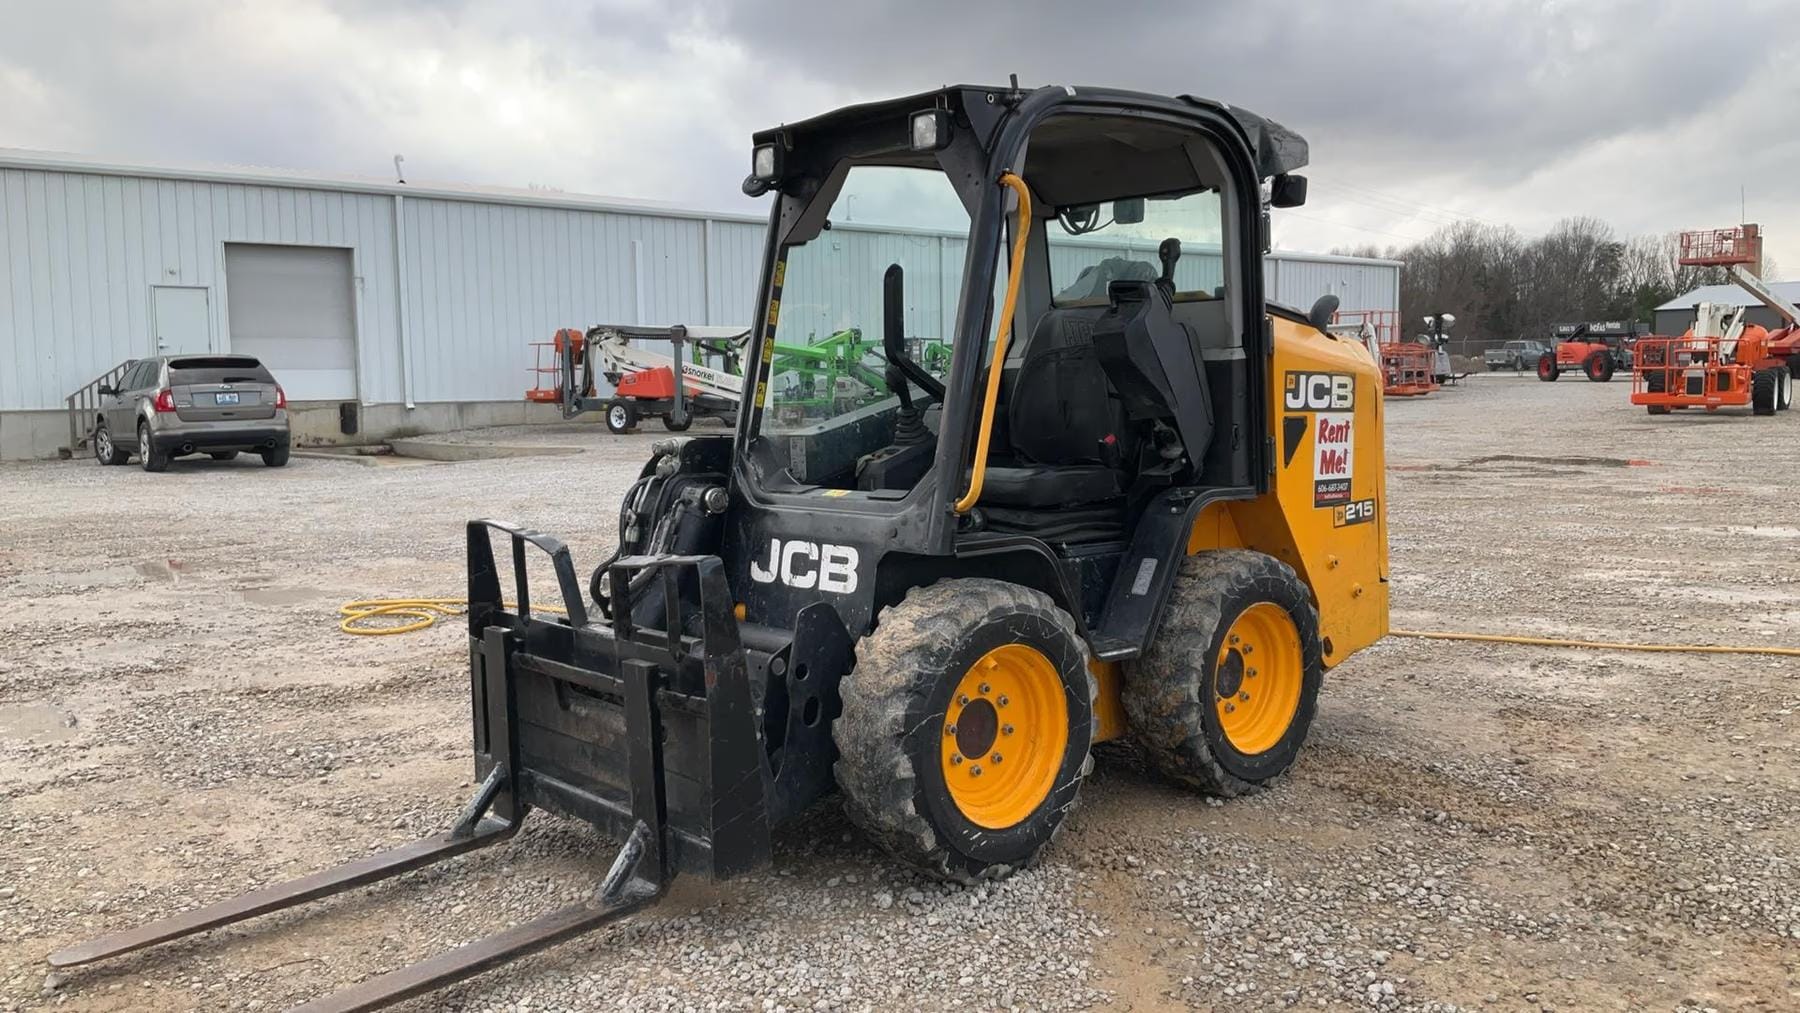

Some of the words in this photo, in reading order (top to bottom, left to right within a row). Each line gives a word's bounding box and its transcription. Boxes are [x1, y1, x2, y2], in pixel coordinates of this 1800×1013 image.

[688, 367, 715, 381] snorkel
[1286, 374, 1354, 409] JCB
[1318, 418, 1350, 444] Rent
[1319, 448, 1348, 475] Me!
[1345, 500, 1374, 520] 215
[750, 538, 859, 594] JCB
